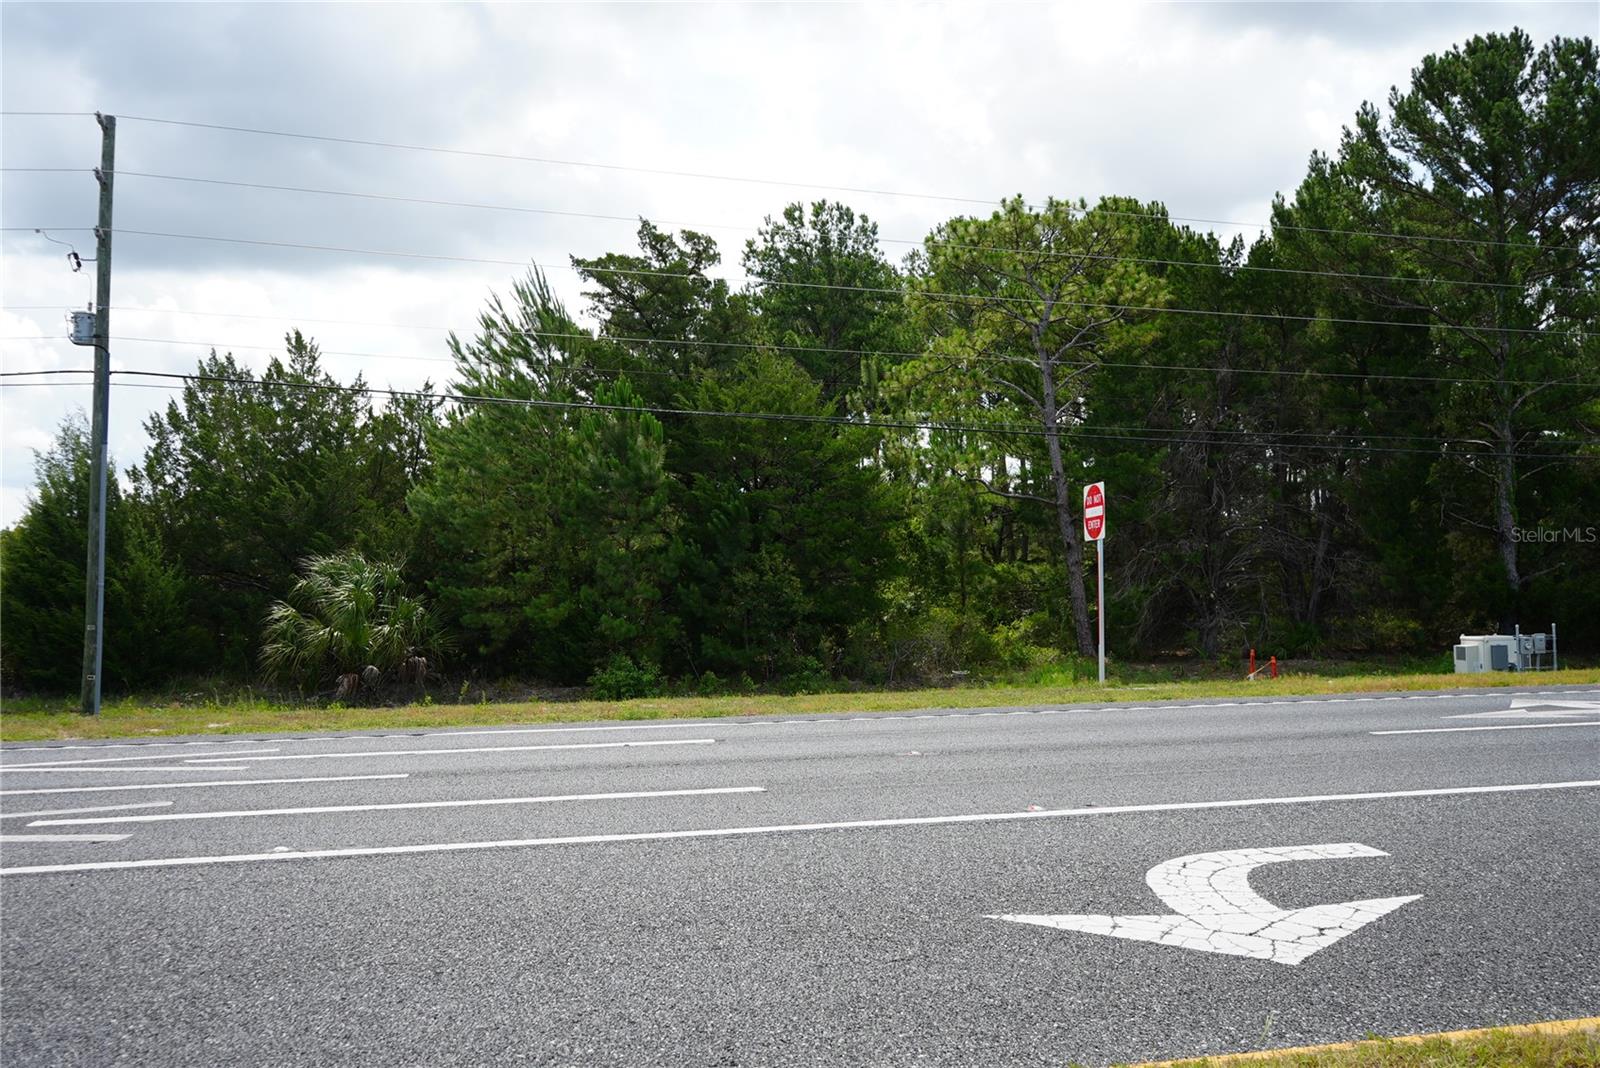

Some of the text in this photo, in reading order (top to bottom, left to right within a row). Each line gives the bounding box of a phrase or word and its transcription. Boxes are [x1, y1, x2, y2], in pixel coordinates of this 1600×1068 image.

[1087, 493, 1102, 505] DO NOT
[1088, 519, 1101, 529] ENTER
